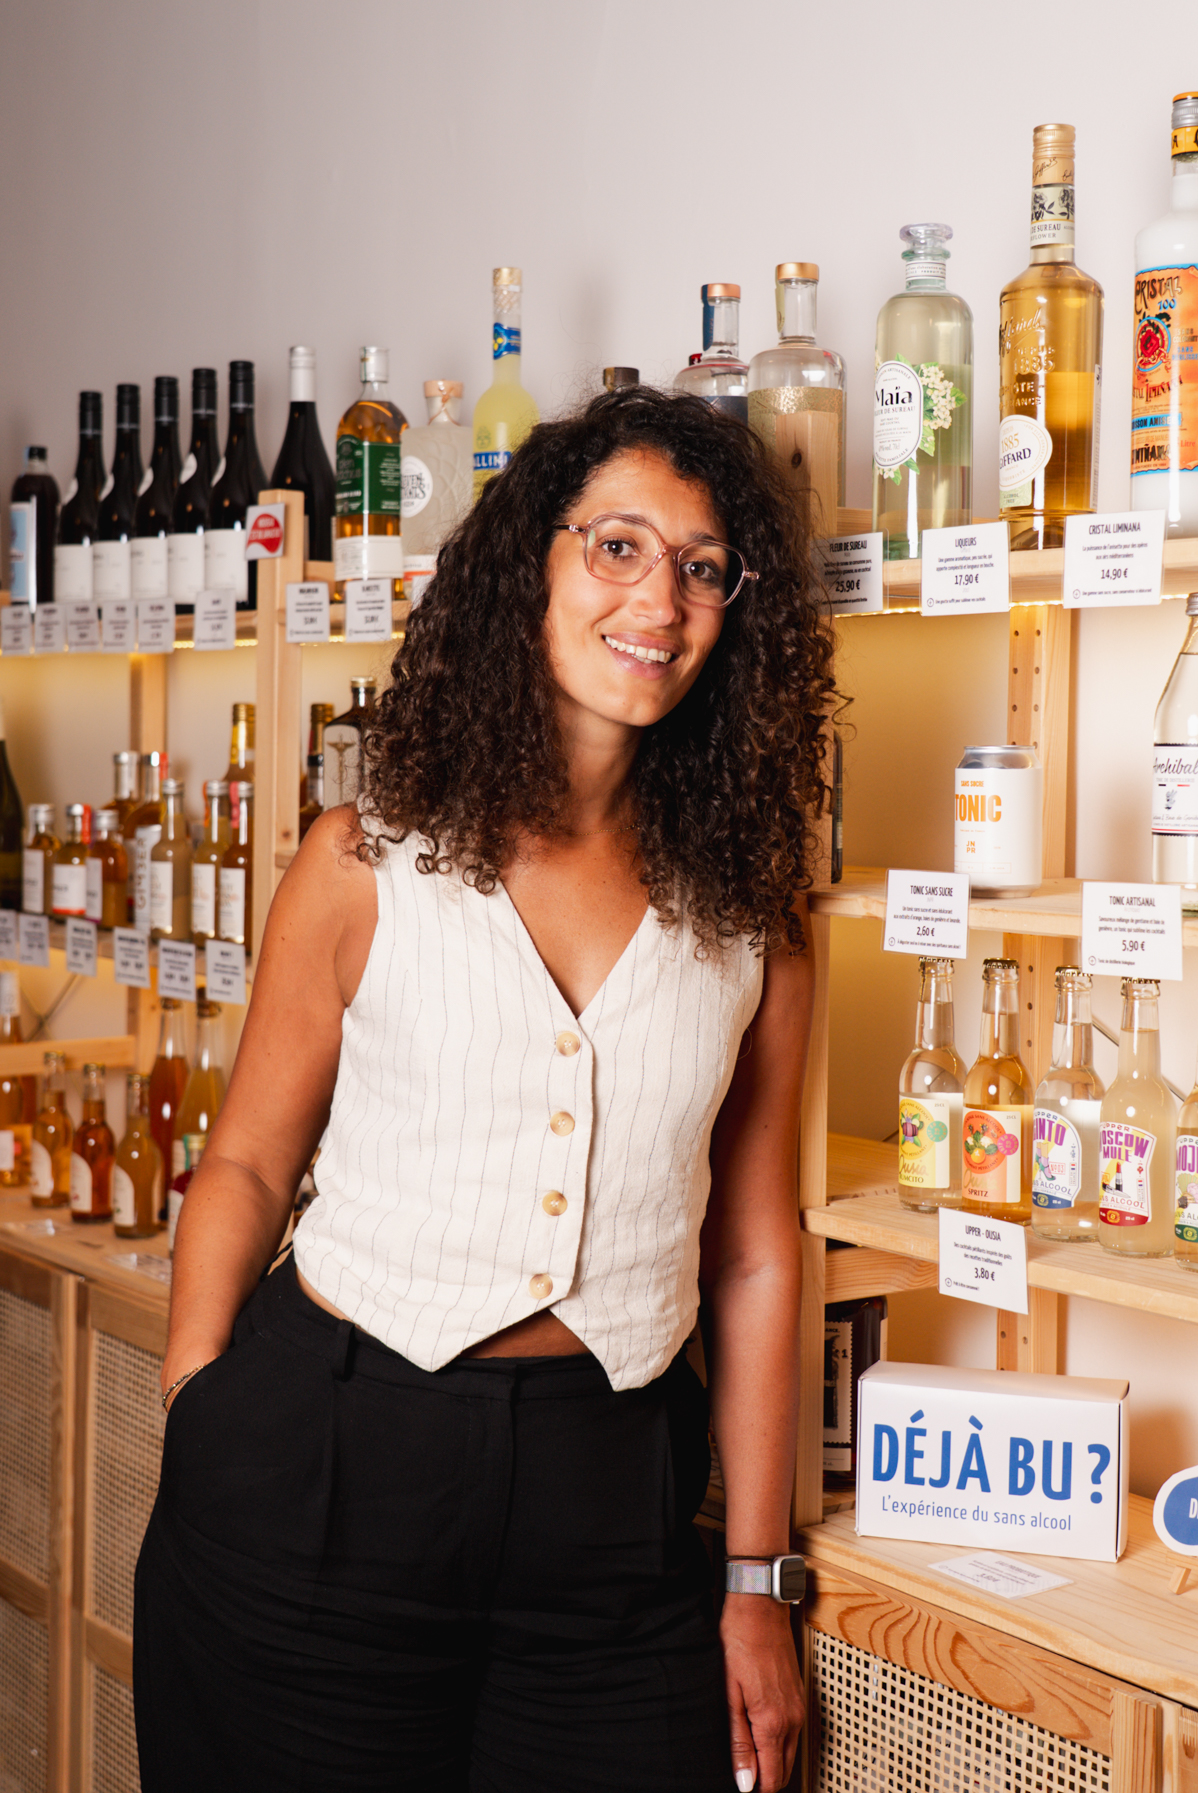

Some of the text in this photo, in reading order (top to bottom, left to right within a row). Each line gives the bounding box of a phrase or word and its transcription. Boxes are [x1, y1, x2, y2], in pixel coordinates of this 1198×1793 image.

[1038, 223, 1061, 231] SUREAU
[1135, 276, 1183, 315] CRISTAL
[1158, 298, 1176, 311] 100
[875, 386, 913, 407] Maïa
[1001, 433, 1019, 453] 1885
[1089, 522, 1141, 535] CRISTAL LIMINANA
[830, 540, 867, 552] FLEUR DE SUREAU
[955, 537, 976, 548] LIQUEURS
[955, 573, 979, 585] 17,90 €
[1101, 568, 1128, 580] 14,90 €
[836, 579, 860, 593] 25,90 €
[955, 794, 1002, 822] TONIC
[910, 885, 953, 897] TONIC SANS SUCRE
[1109, 896, 1156, 907] TONIC ARTISANAL
[917, 926, 935, 937] 2,60 €
[1122, 940, 1145, 952] 5,90 €
[1100, 1130, 1149, 1158] OSCOW
[1103, 1146, 1132, 1163] MULE
[968, 1188, 988, 1197] SPRITZ
[1040, 1180, 1072, 1196] ALCOOL
[1111, 1197, 1145, 1209] ALCOOL
[965, 1225, 981, 1237] UPPER
[986, 1230, 1001, 1241] OUSIA
[960, 1243, 972, 1251] cocktails
[974, 1267, 995, 1281] 3,80 €
[873, 1409, 1111, 1504] DÉJÀ BU ?
[882, 1495, 1071, 1531] L'expérience du sans alcool
[1189, 1498, 1198, 1519] D
